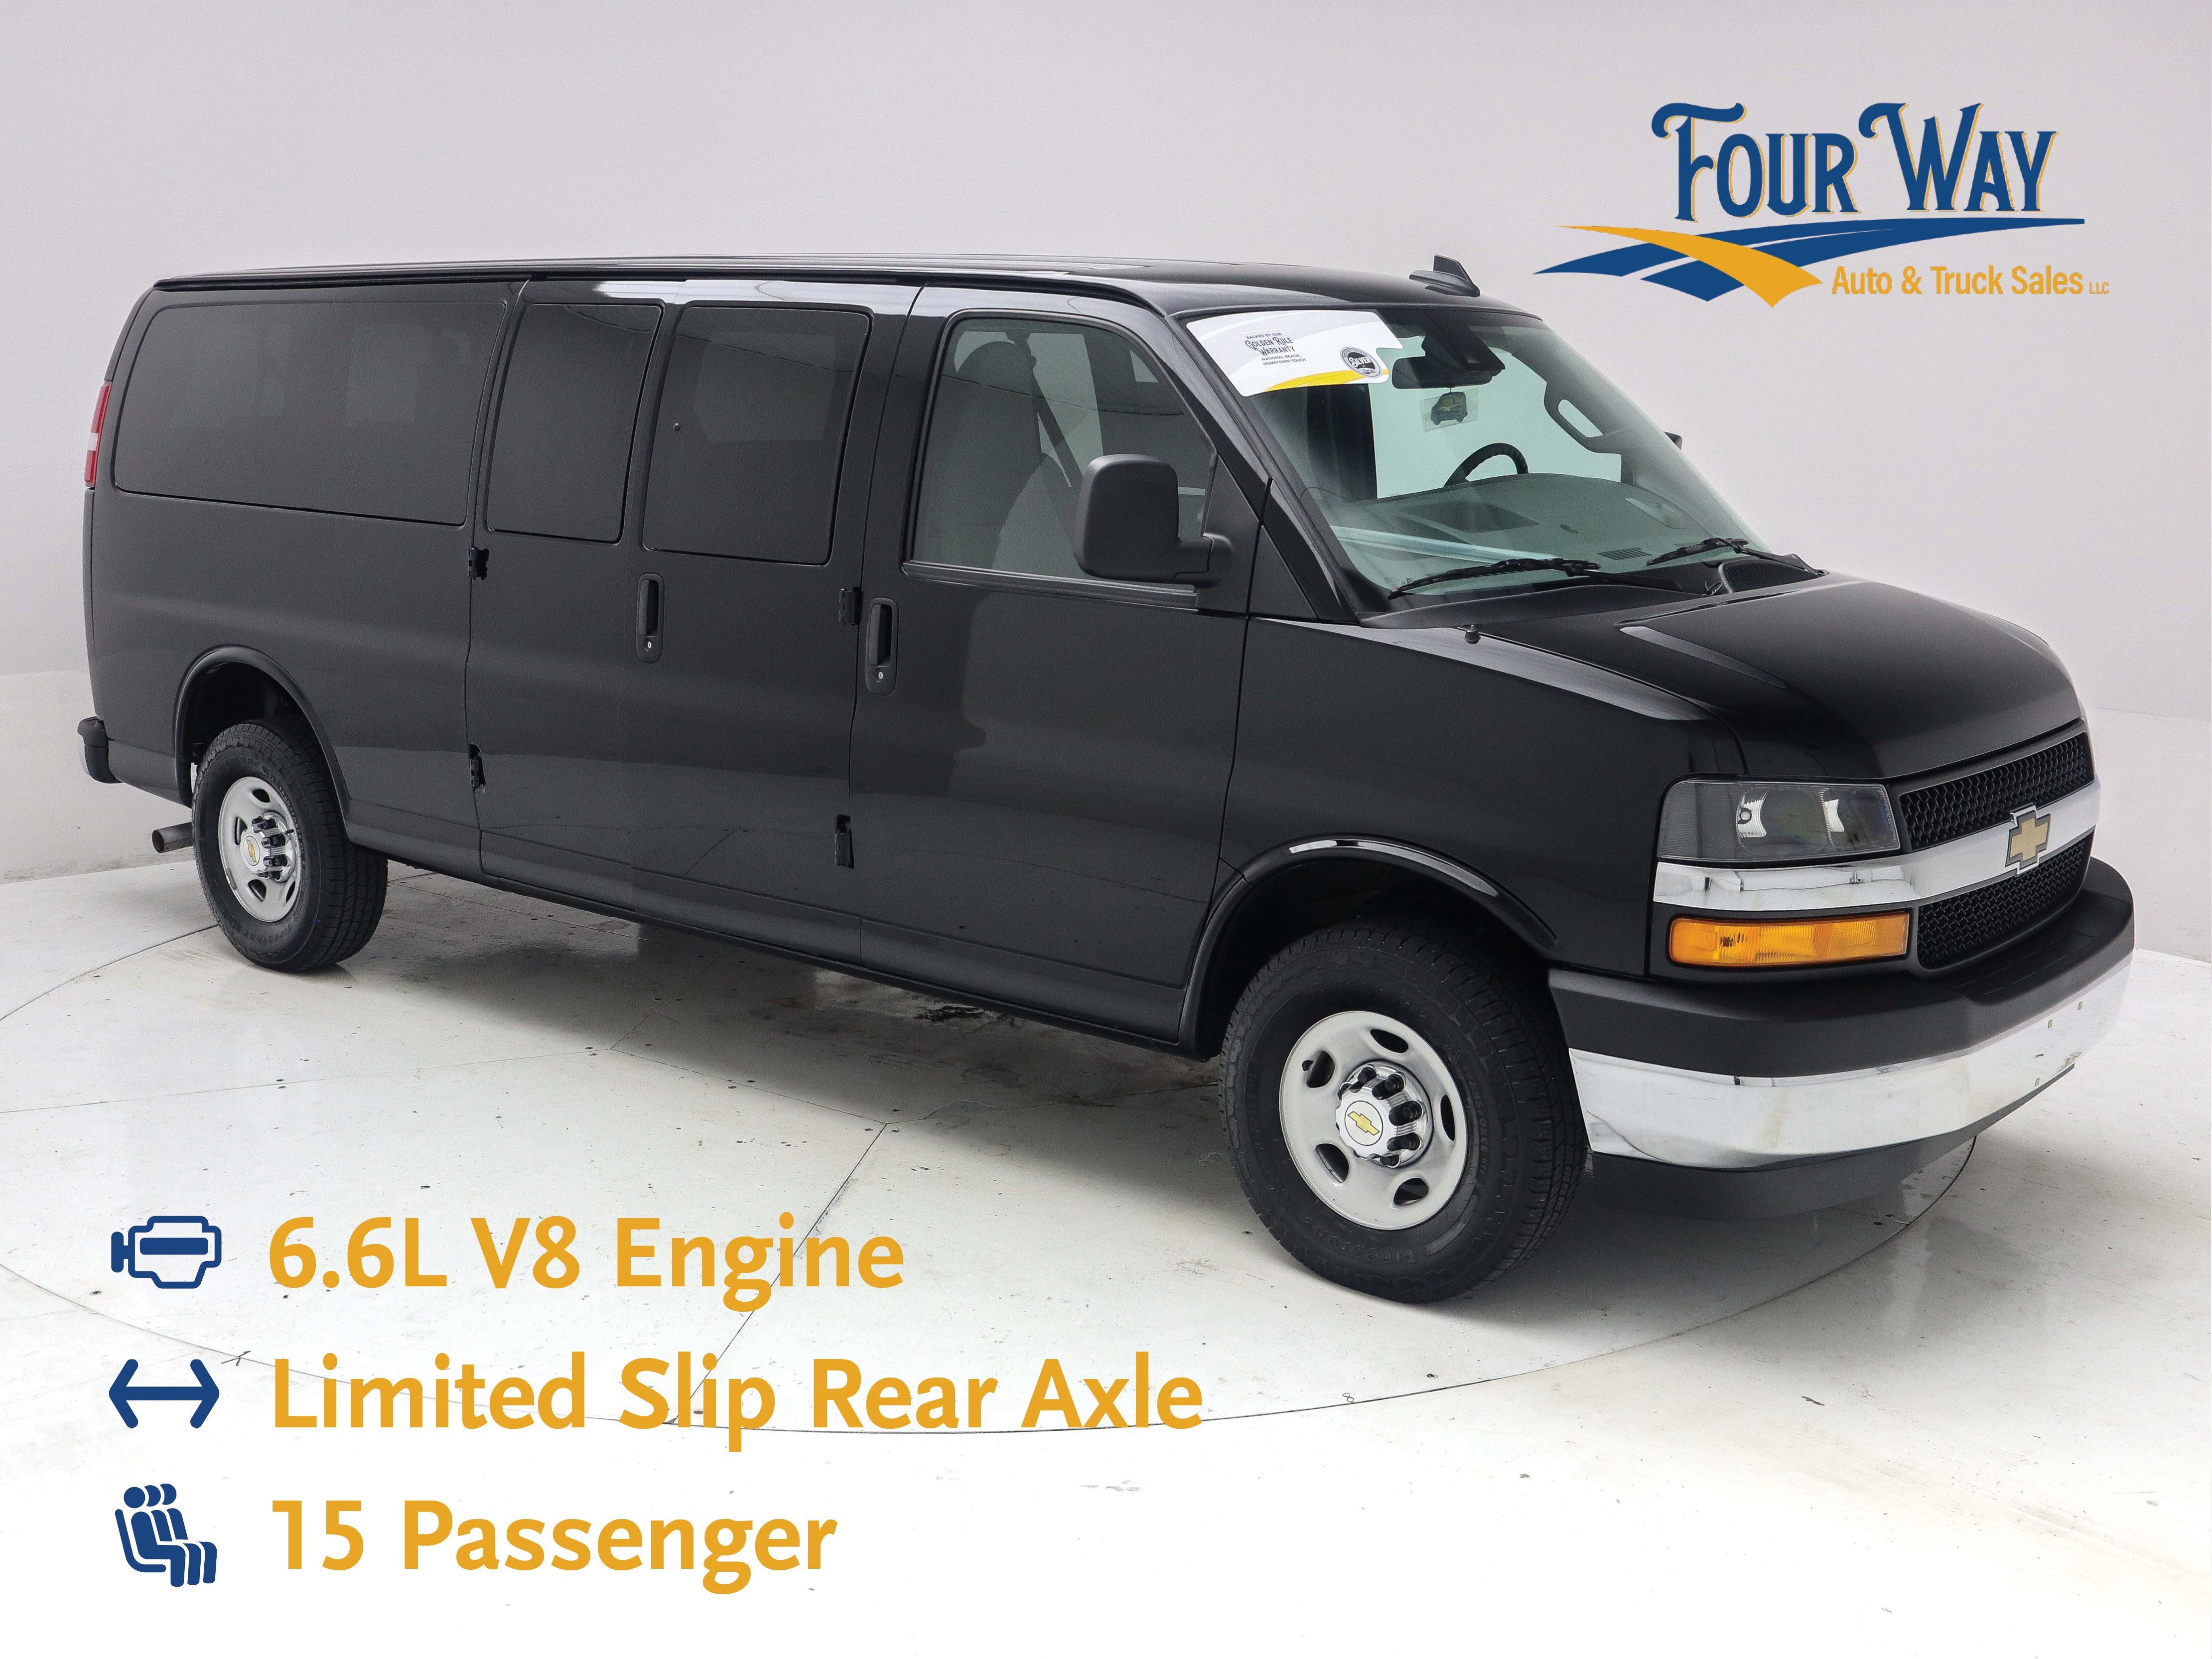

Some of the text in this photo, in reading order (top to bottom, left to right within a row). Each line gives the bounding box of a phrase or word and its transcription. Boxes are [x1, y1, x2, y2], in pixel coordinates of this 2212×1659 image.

[1245, 337, 1293, 349] GOLDEN RULE
[1254, 346, 1295, 356] WARRANTY
[1349, 356, 1372, 367] SILVER
